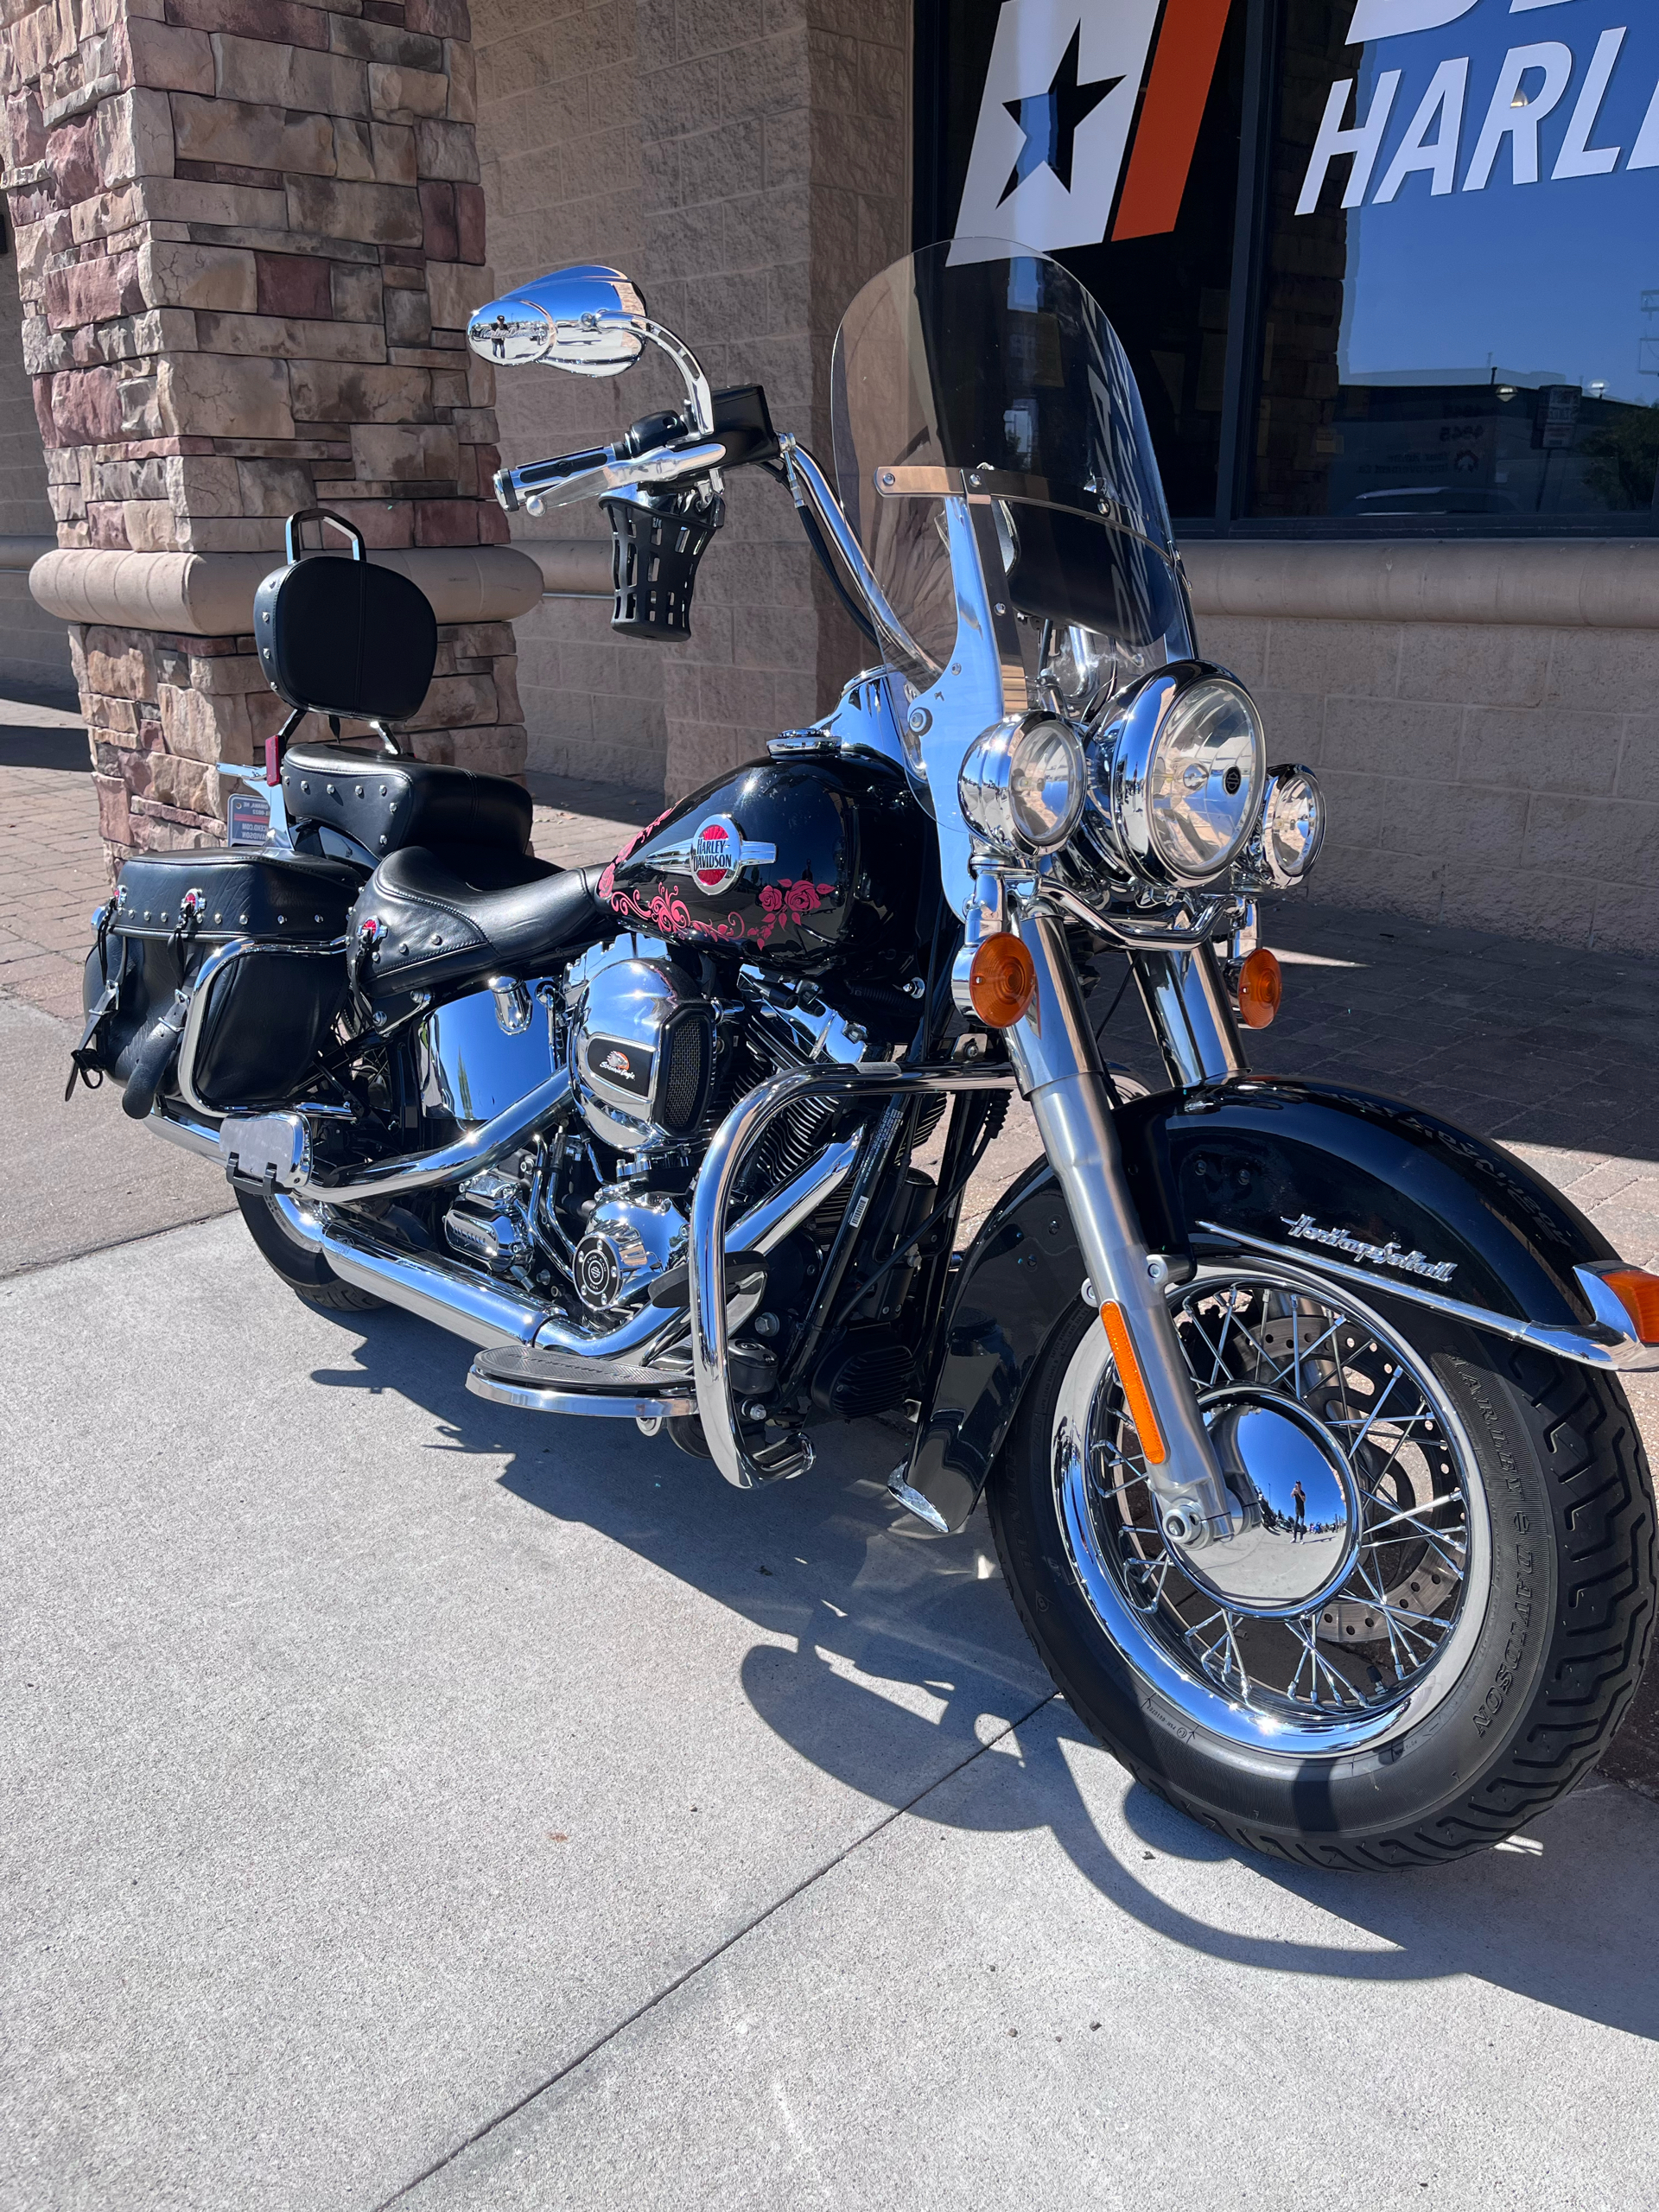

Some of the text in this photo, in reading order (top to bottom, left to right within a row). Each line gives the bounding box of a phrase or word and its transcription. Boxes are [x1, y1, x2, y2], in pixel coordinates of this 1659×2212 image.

[693, 854, 732, 872] DAVIDSON
[1440, 1344, 1524, 1500] HARLEY
[1471, 1544, 1533, 1738] DAVIDSON
